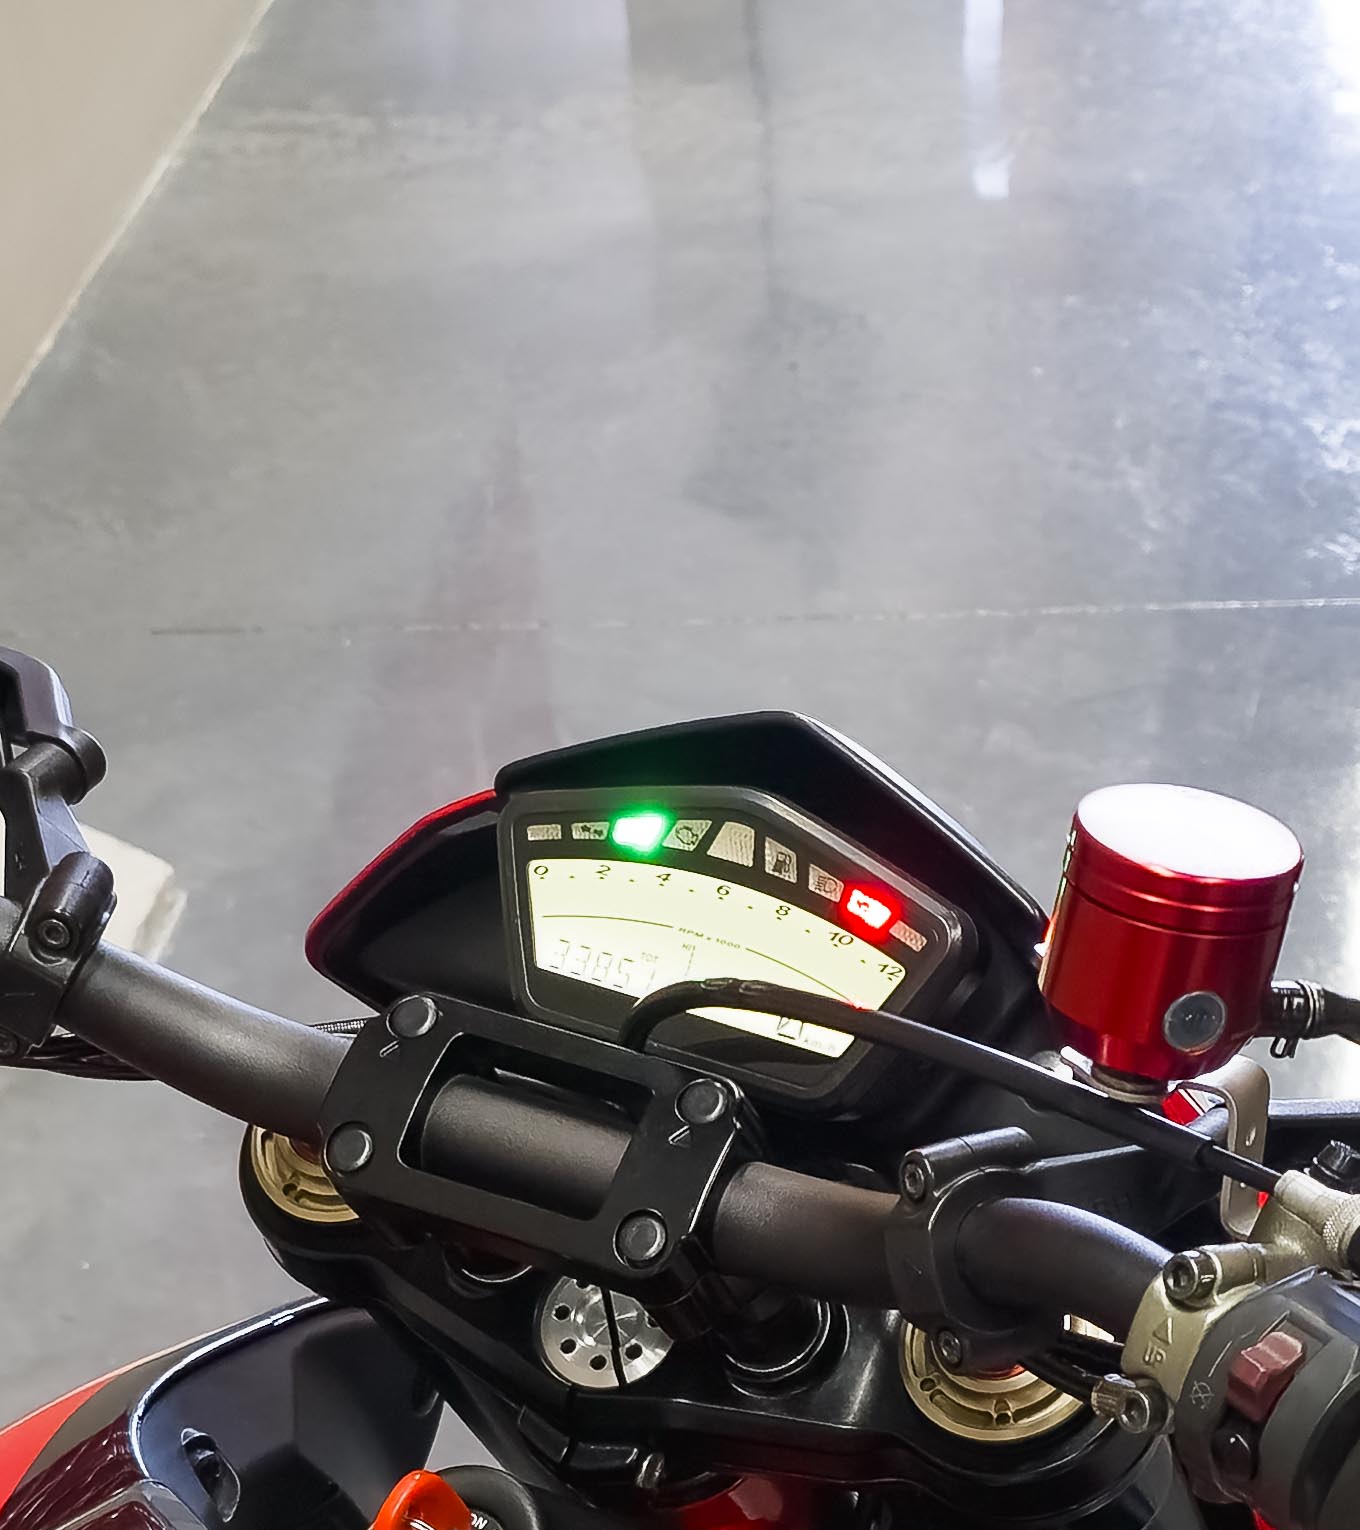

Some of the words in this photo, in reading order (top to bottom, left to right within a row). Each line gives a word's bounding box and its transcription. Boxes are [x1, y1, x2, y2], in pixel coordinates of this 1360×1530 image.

[534, 865, 549, 876] 0
[595, 865, 611, 876] 2
[656, 873, 672, 882] 4
[716, 885, 732, 896] 6
[775, 905, 791, 916] 8
[829, 931, 854, 946] 10
[878, 963, 903, 979] 12
[1143, 1341, 1167, 1367] UP
